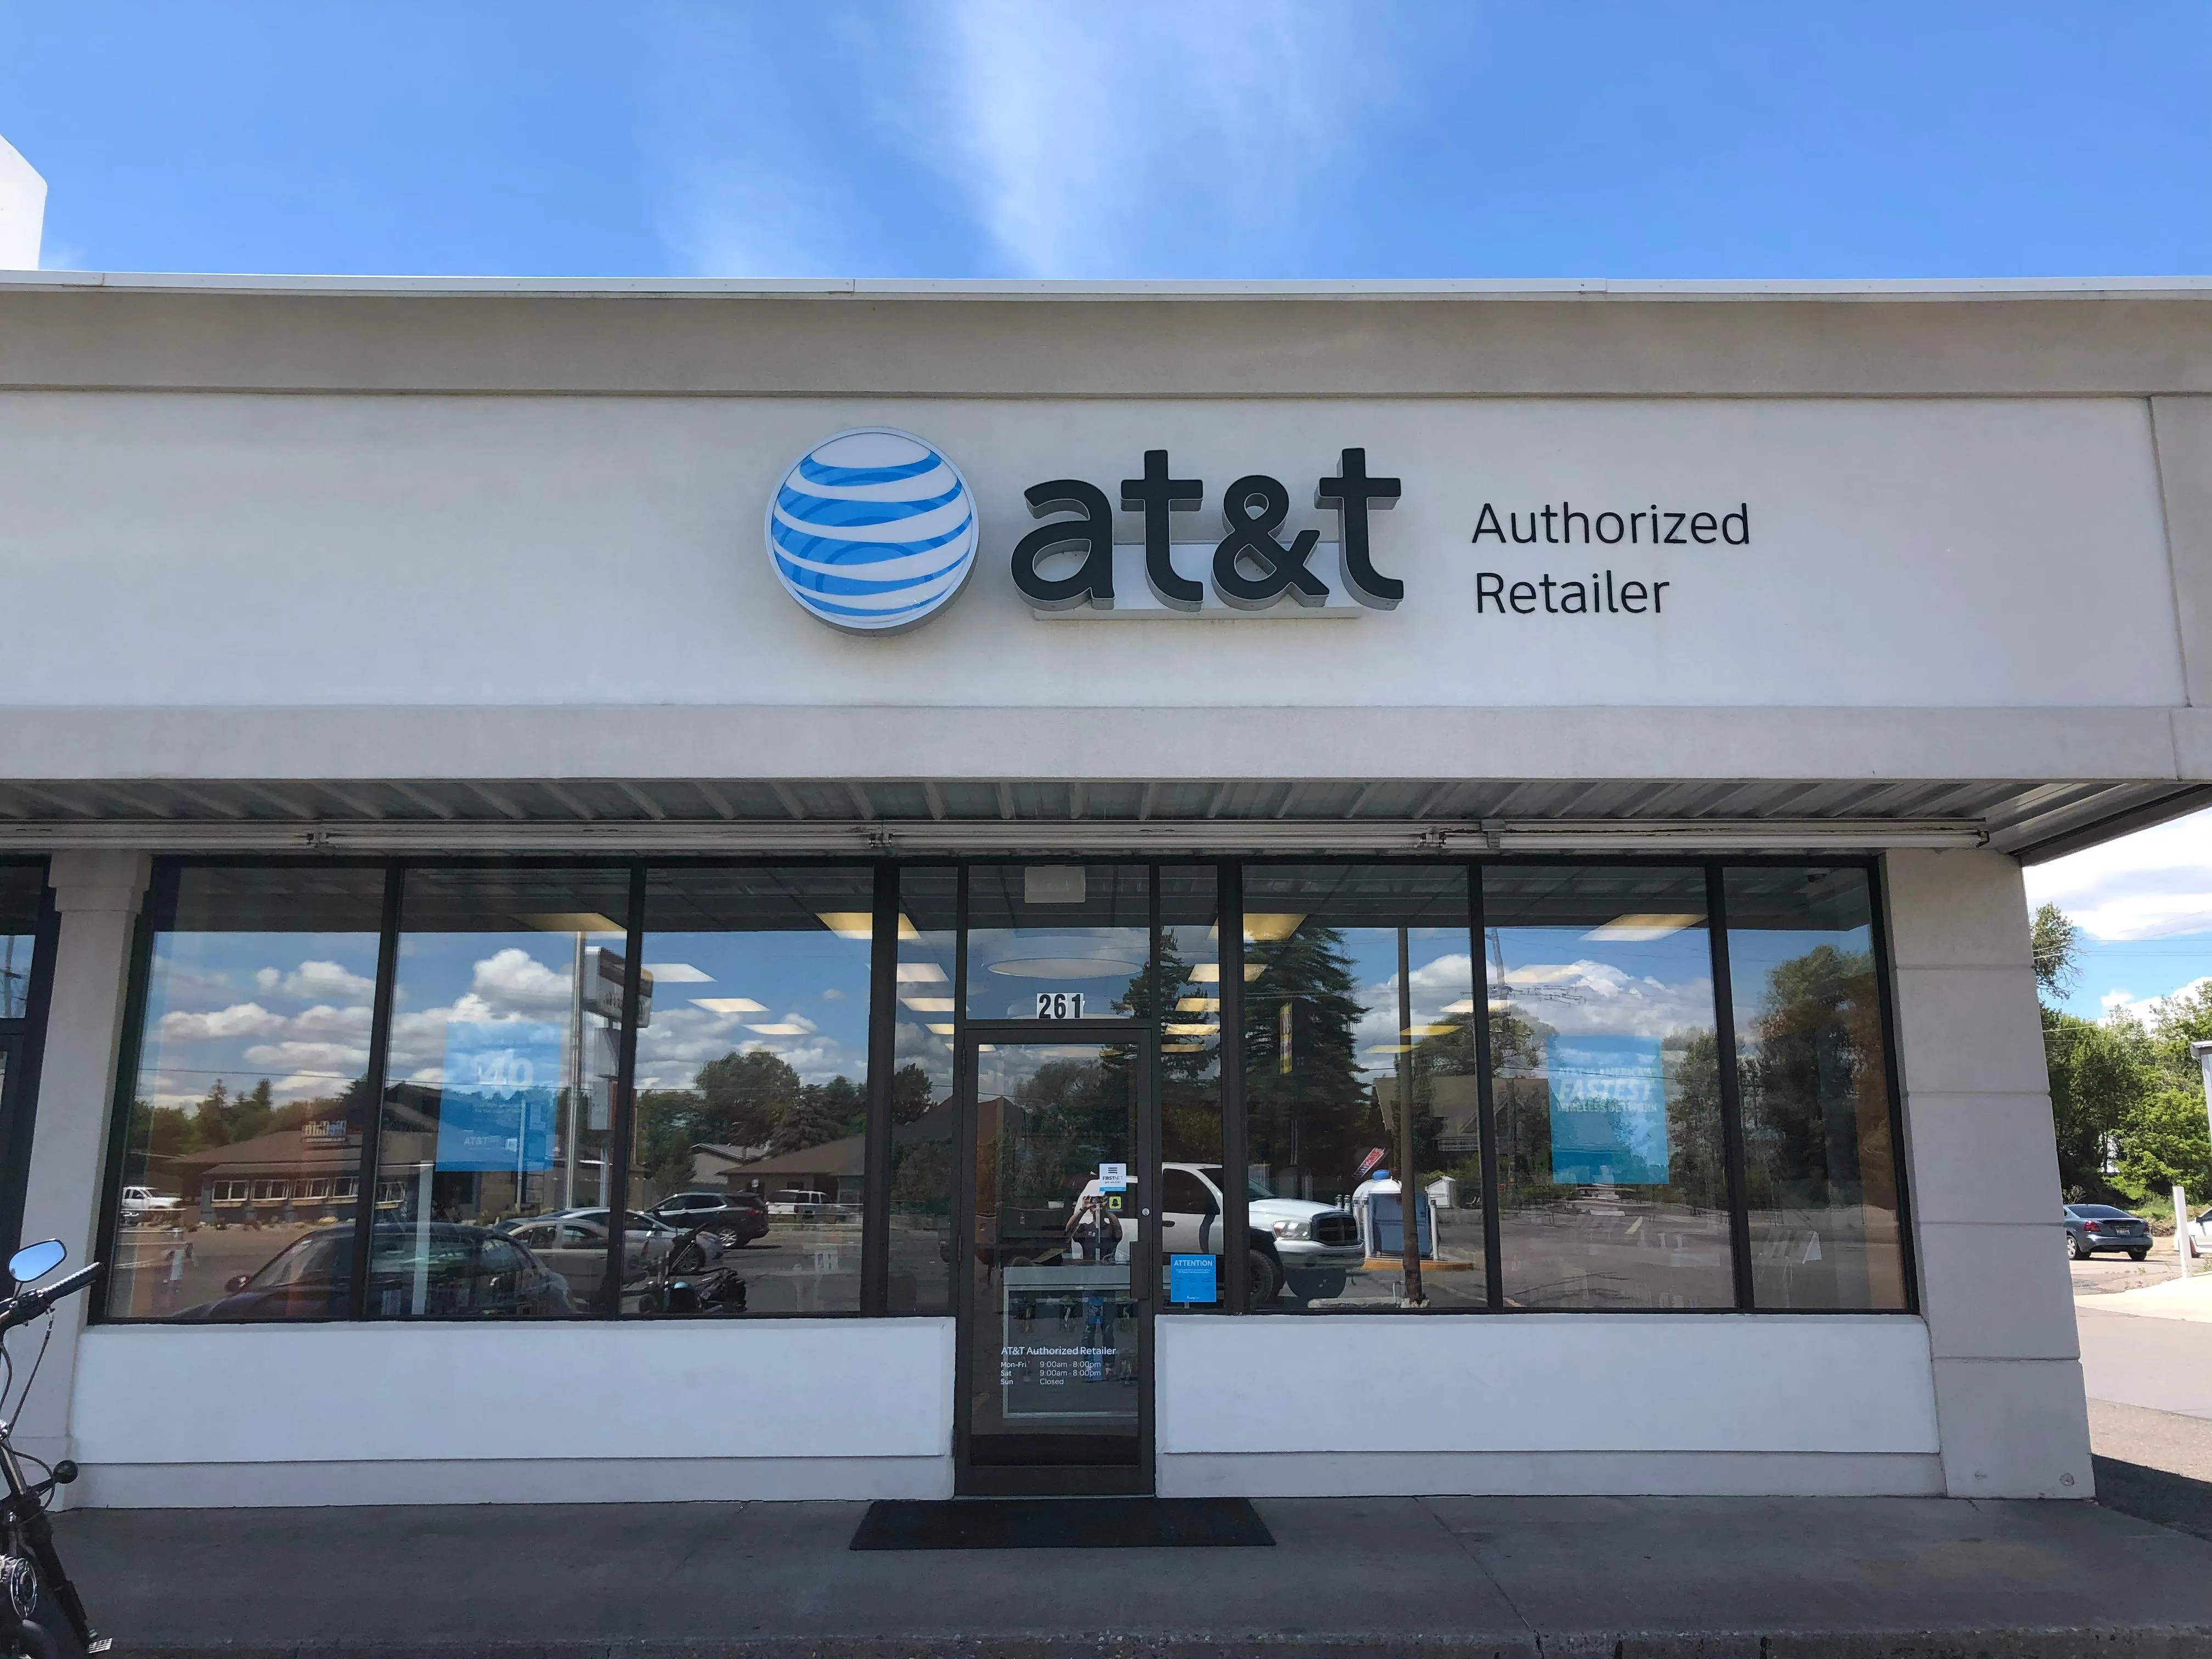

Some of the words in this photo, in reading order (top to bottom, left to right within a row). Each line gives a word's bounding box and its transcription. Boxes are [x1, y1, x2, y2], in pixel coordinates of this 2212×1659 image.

[1010, 448, 1404, 611] at&t
[1472, 501, 1749, 545] Authorized
[1476, 569, 1669, 613] Retailer
[1039, 994, 1081, 1019] 261
[1559, 1079, 1654, 1101] FASTEST
[1001, 1346, 1025, 1355] AT&T
[1026, 1346, 1079, 1355] Authorized
[1080, 1346, 1116, 1355] Retailer
